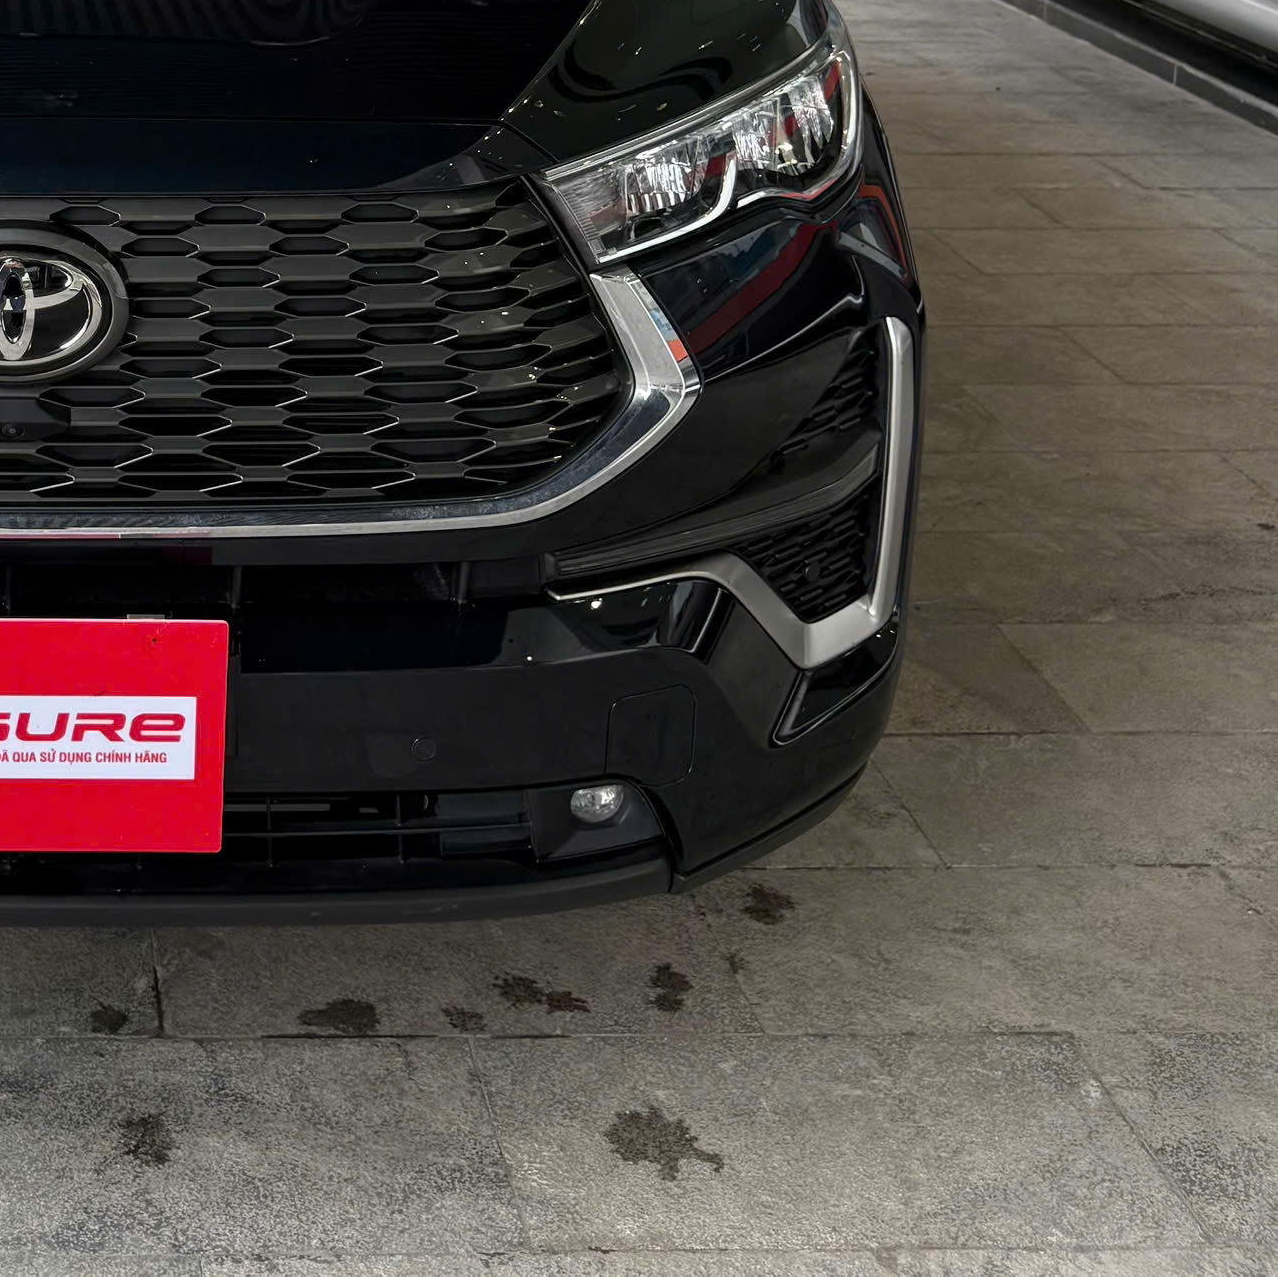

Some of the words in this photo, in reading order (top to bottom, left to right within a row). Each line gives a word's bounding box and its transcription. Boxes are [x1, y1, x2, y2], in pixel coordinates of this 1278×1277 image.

[13, 751, 37, 764] QUA
[39, 748, 57, 764] SỬ
[59, 751, 92, 766] DỤNG
[95, 749, 132, 764] CHÍNH
[135, 749, 168, 764] HÃNG
